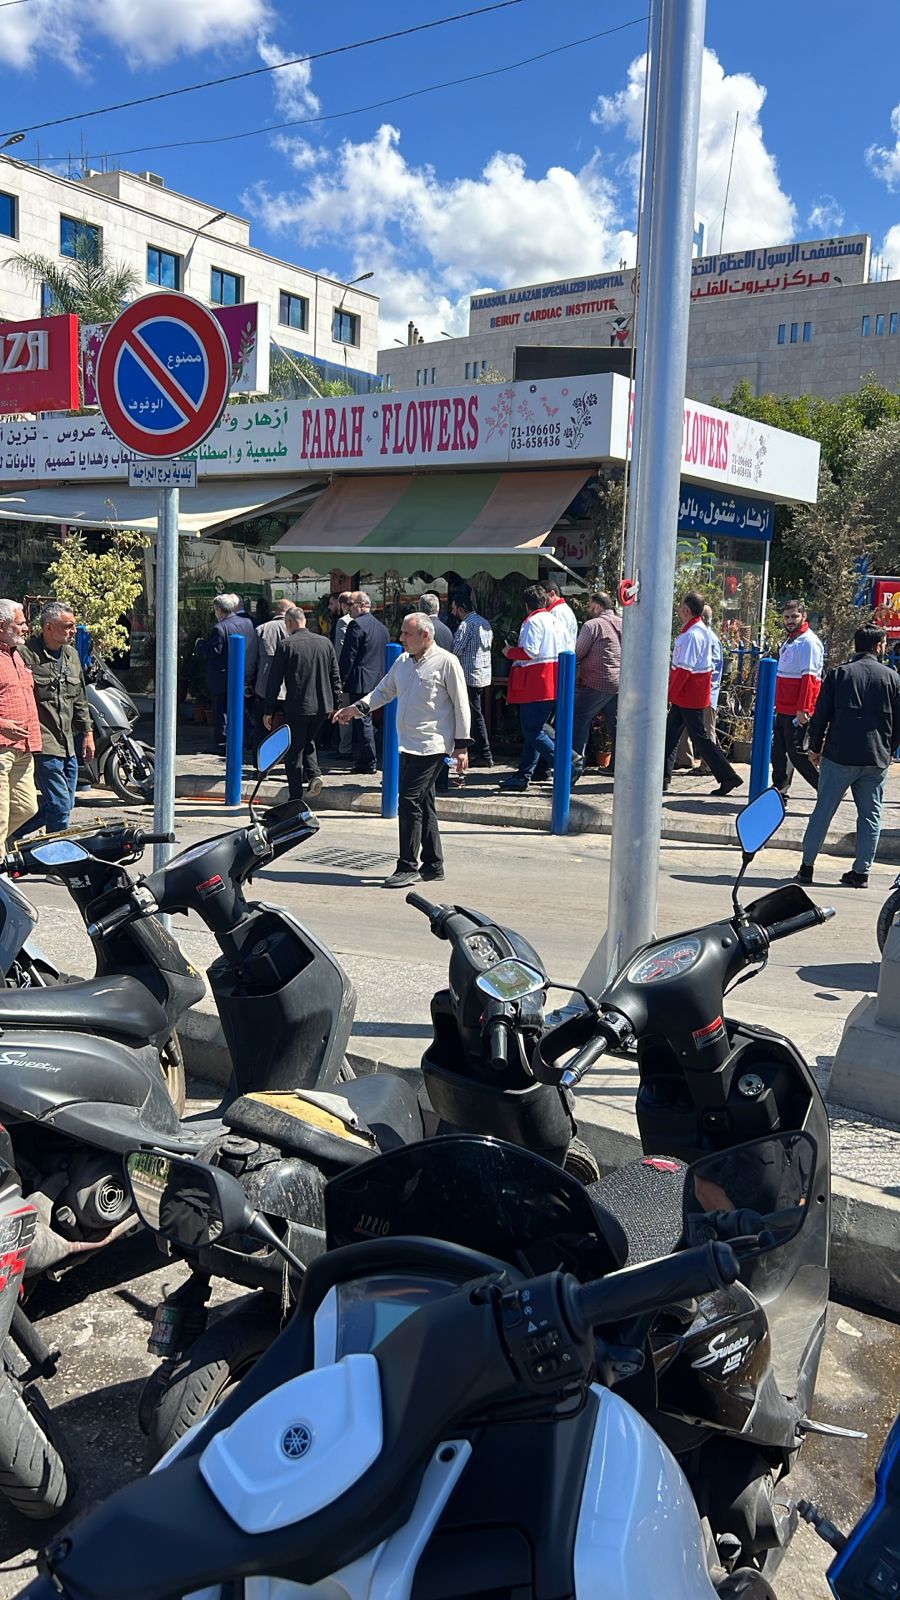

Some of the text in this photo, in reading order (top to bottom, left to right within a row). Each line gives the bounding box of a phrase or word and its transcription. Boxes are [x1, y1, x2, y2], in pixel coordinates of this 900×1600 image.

[757, 244, 799, 271] الرسول
[801, 239, 864, 261] مستشفى
[542, 281, 587, 299] SPECIALIZED
[587, 274, 625, 291] HOSPITAL
[728, 275, 780, 295] بيروت
[782, 270, 830, 290] مركز
[490, 298, 616, 328] BEIRUT CARDIAC INSTITUTE
[166, 352, 202, 370] ممنوع
[127, 398, 164, 414] الوقوف
[241, 405, 289, 431] أزهار
[300, 394, 479, 460] FARAH FLOWERS
[6, 426, 37, 446] تزين
[57, 427, 96, 443] عروس
[511, 422, 561, 438] 71-196605
[682, 409, 729, 471] LOWERS
[246, 440, 288, 463] طبيعية
[510, 435, 560, 450] 03-658436
[5, 453, 36, 472] بالونات
[44, 450, 75, 472] تصميم
[132, 462, 192, 484] بلدية برج البراجنة
[703, 500, 736, 525] شتول
